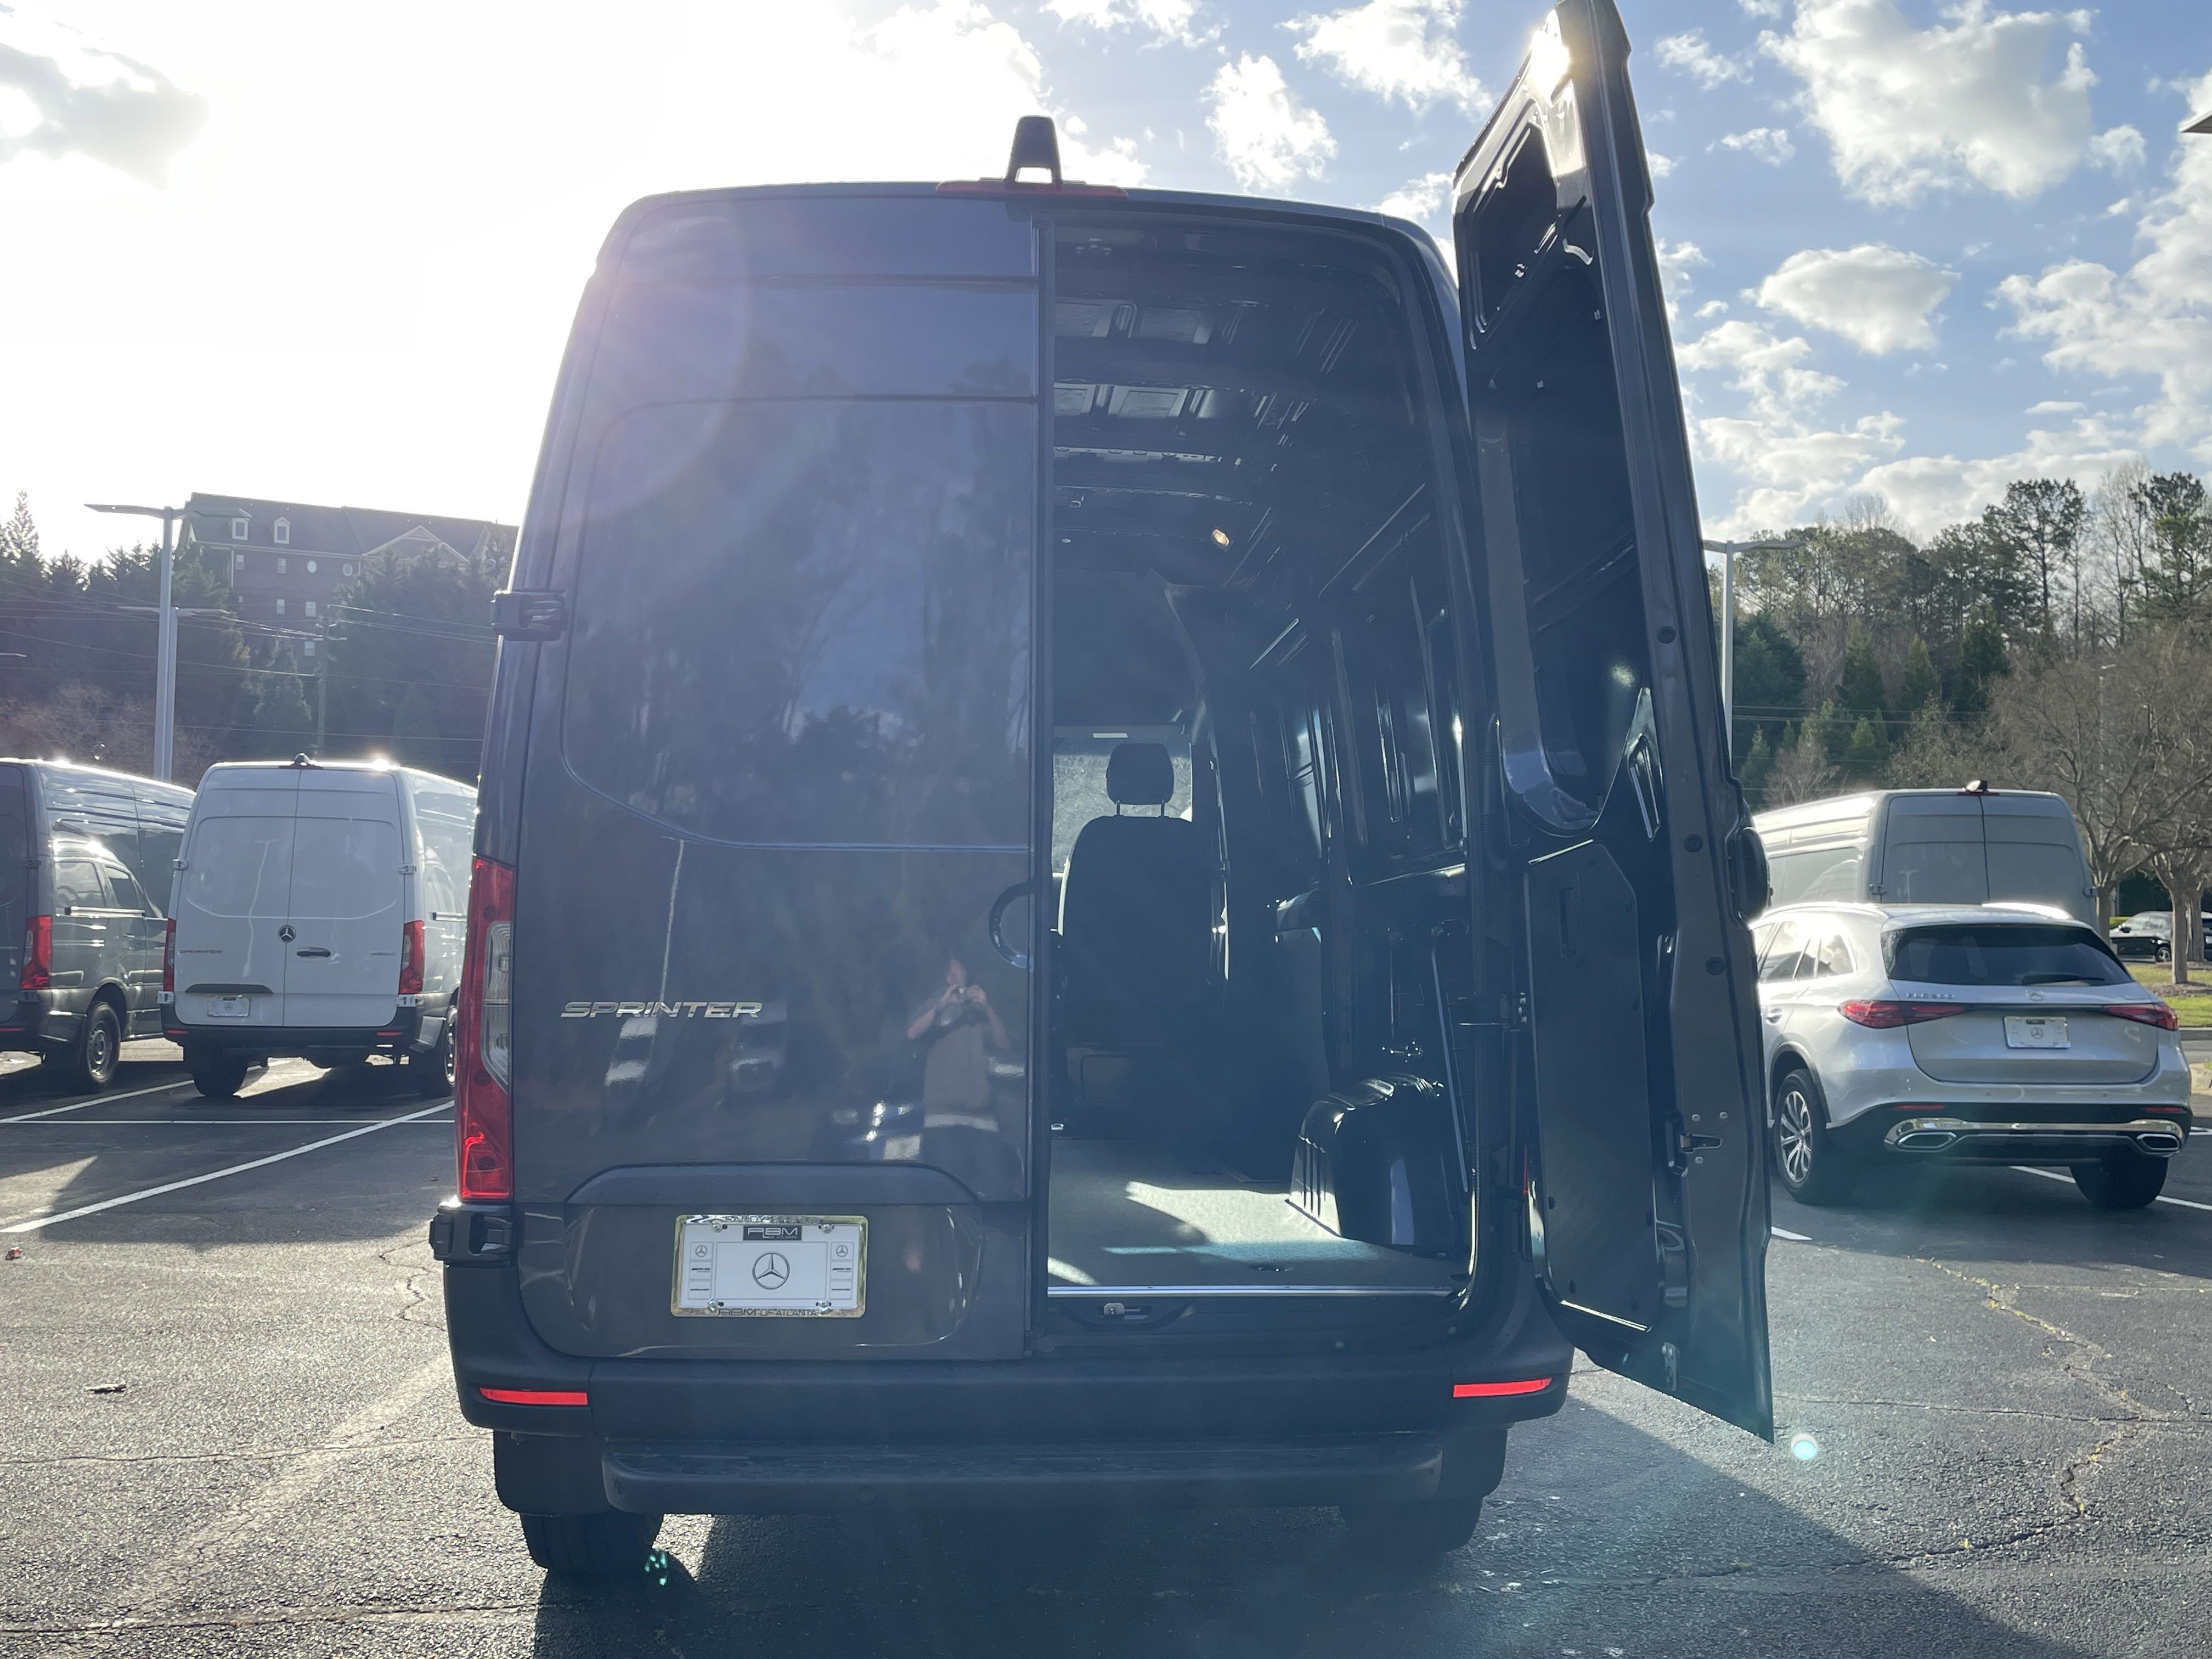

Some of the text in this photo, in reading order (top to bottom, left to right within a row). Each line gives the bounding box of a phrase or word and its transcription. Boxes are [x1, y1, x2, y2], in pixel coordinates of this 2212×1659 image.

[561, 1002, 763, 1018] SPRINTER
[748, 1227, 798, 1238] RBM
[718, 1308, 756, 1316] RBM
